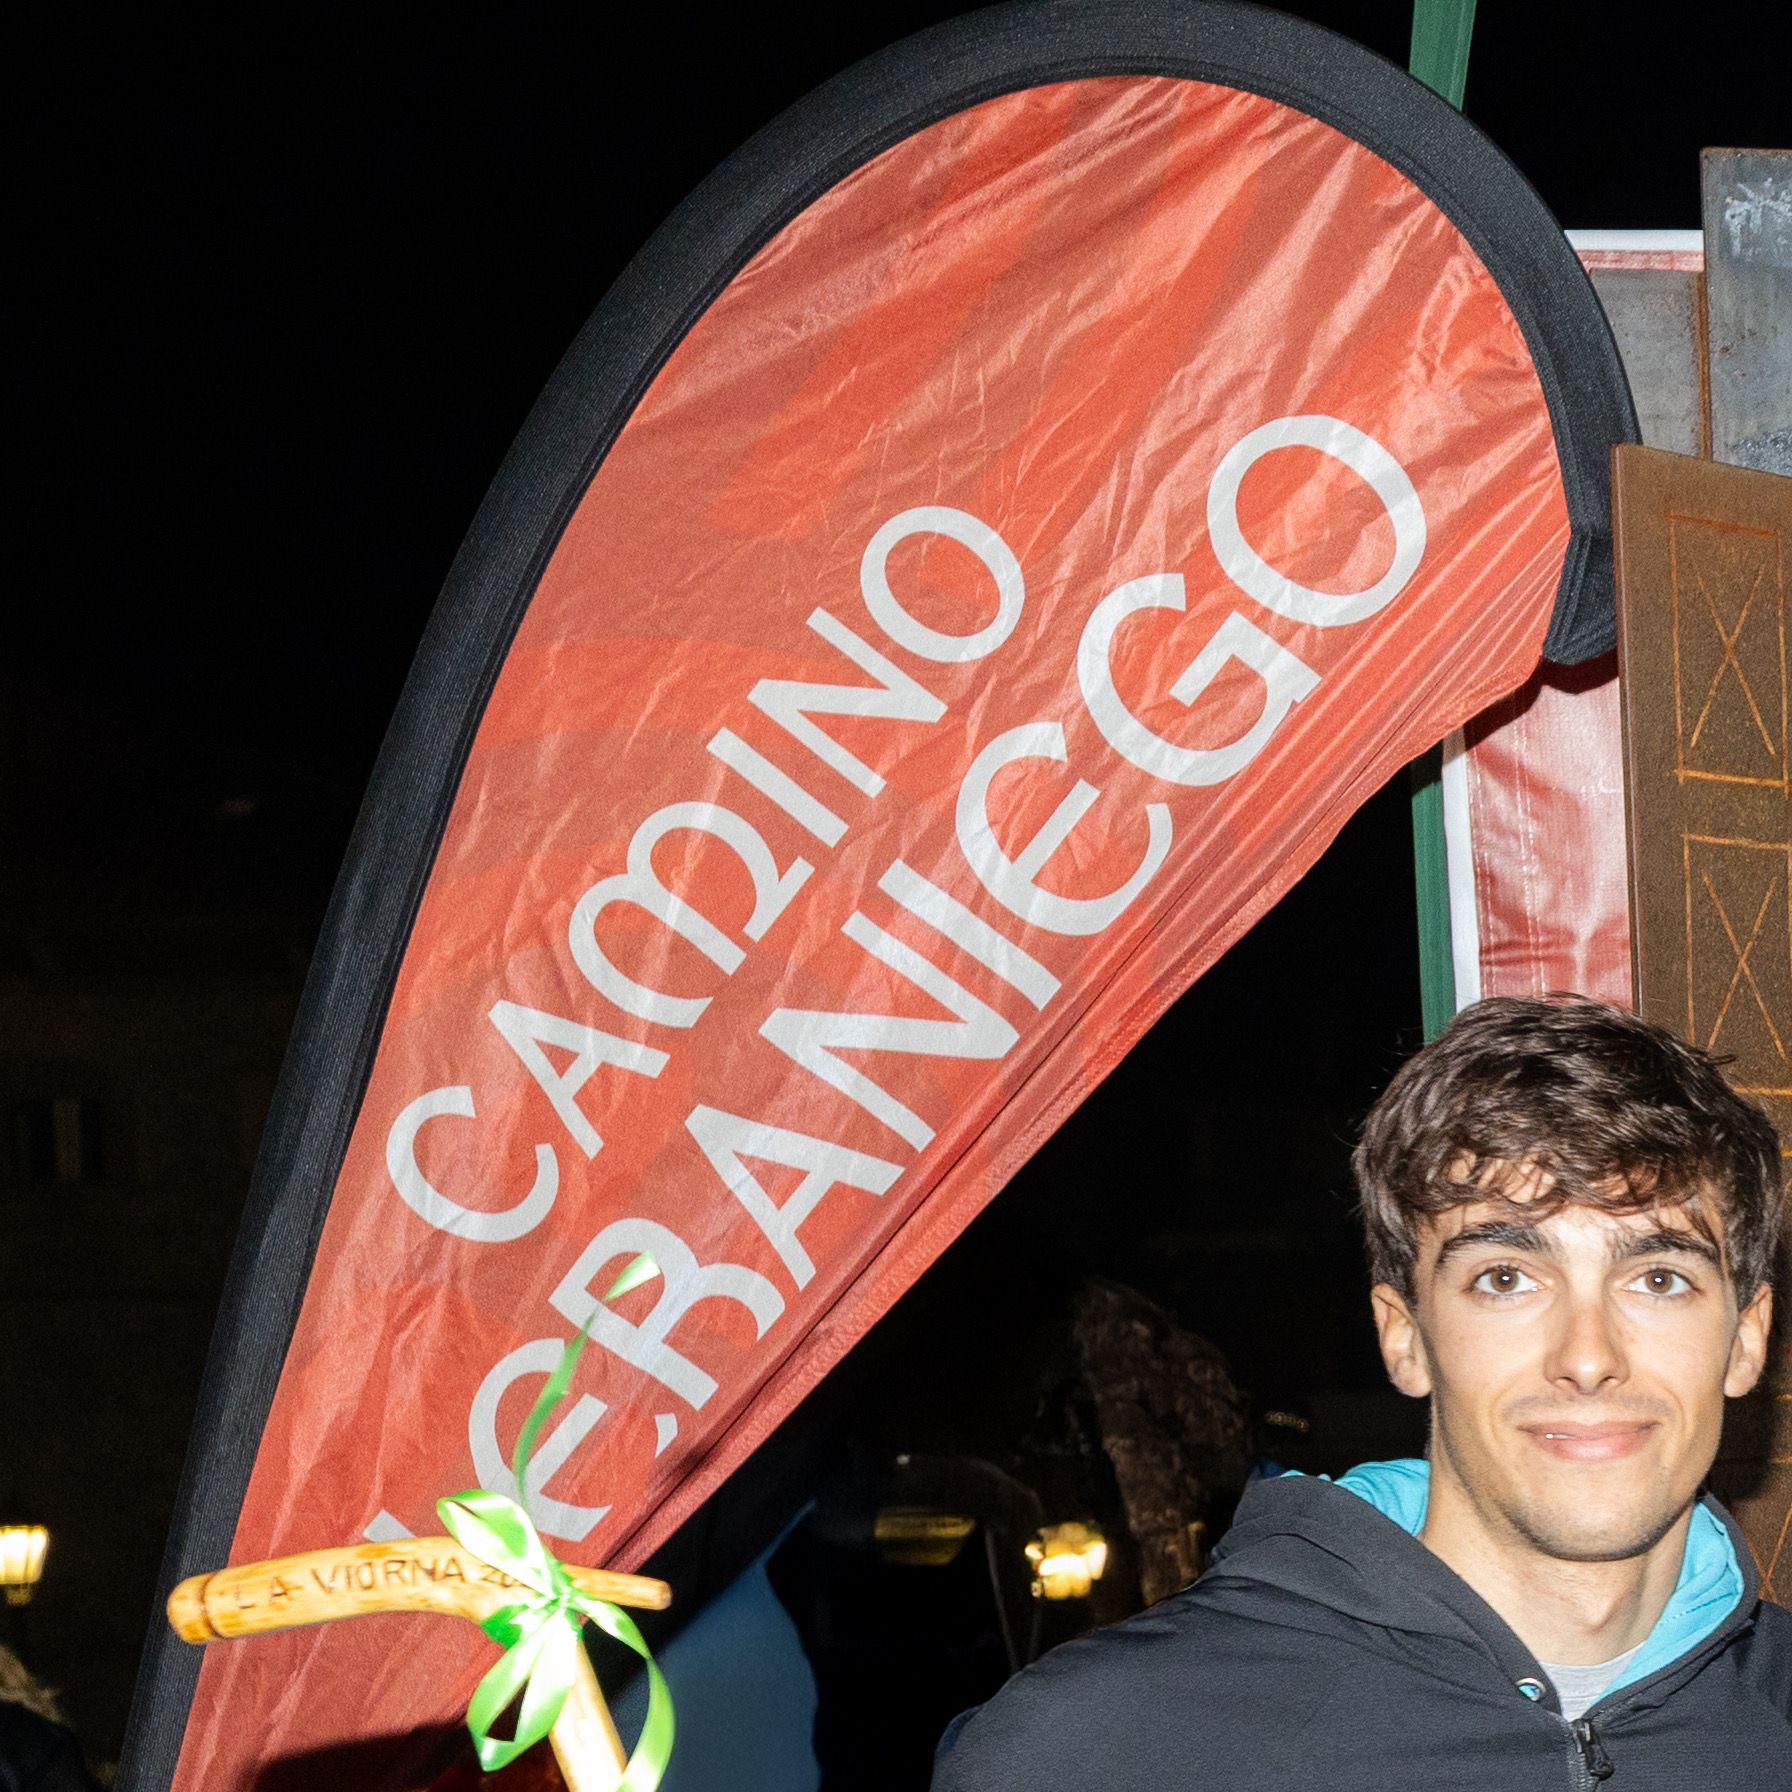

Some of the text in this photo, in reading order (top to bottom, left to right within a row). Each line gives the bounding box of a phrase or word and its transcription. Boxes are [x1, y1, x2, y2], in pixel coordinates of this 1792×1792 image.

[363, 413, 1428, 1545] EBANIEGO
[385, 505, 1026, 1244] CAMINO
[233, 1575, 293, 1610] LA
[311, 1556, 467, 1595] VIORNA
